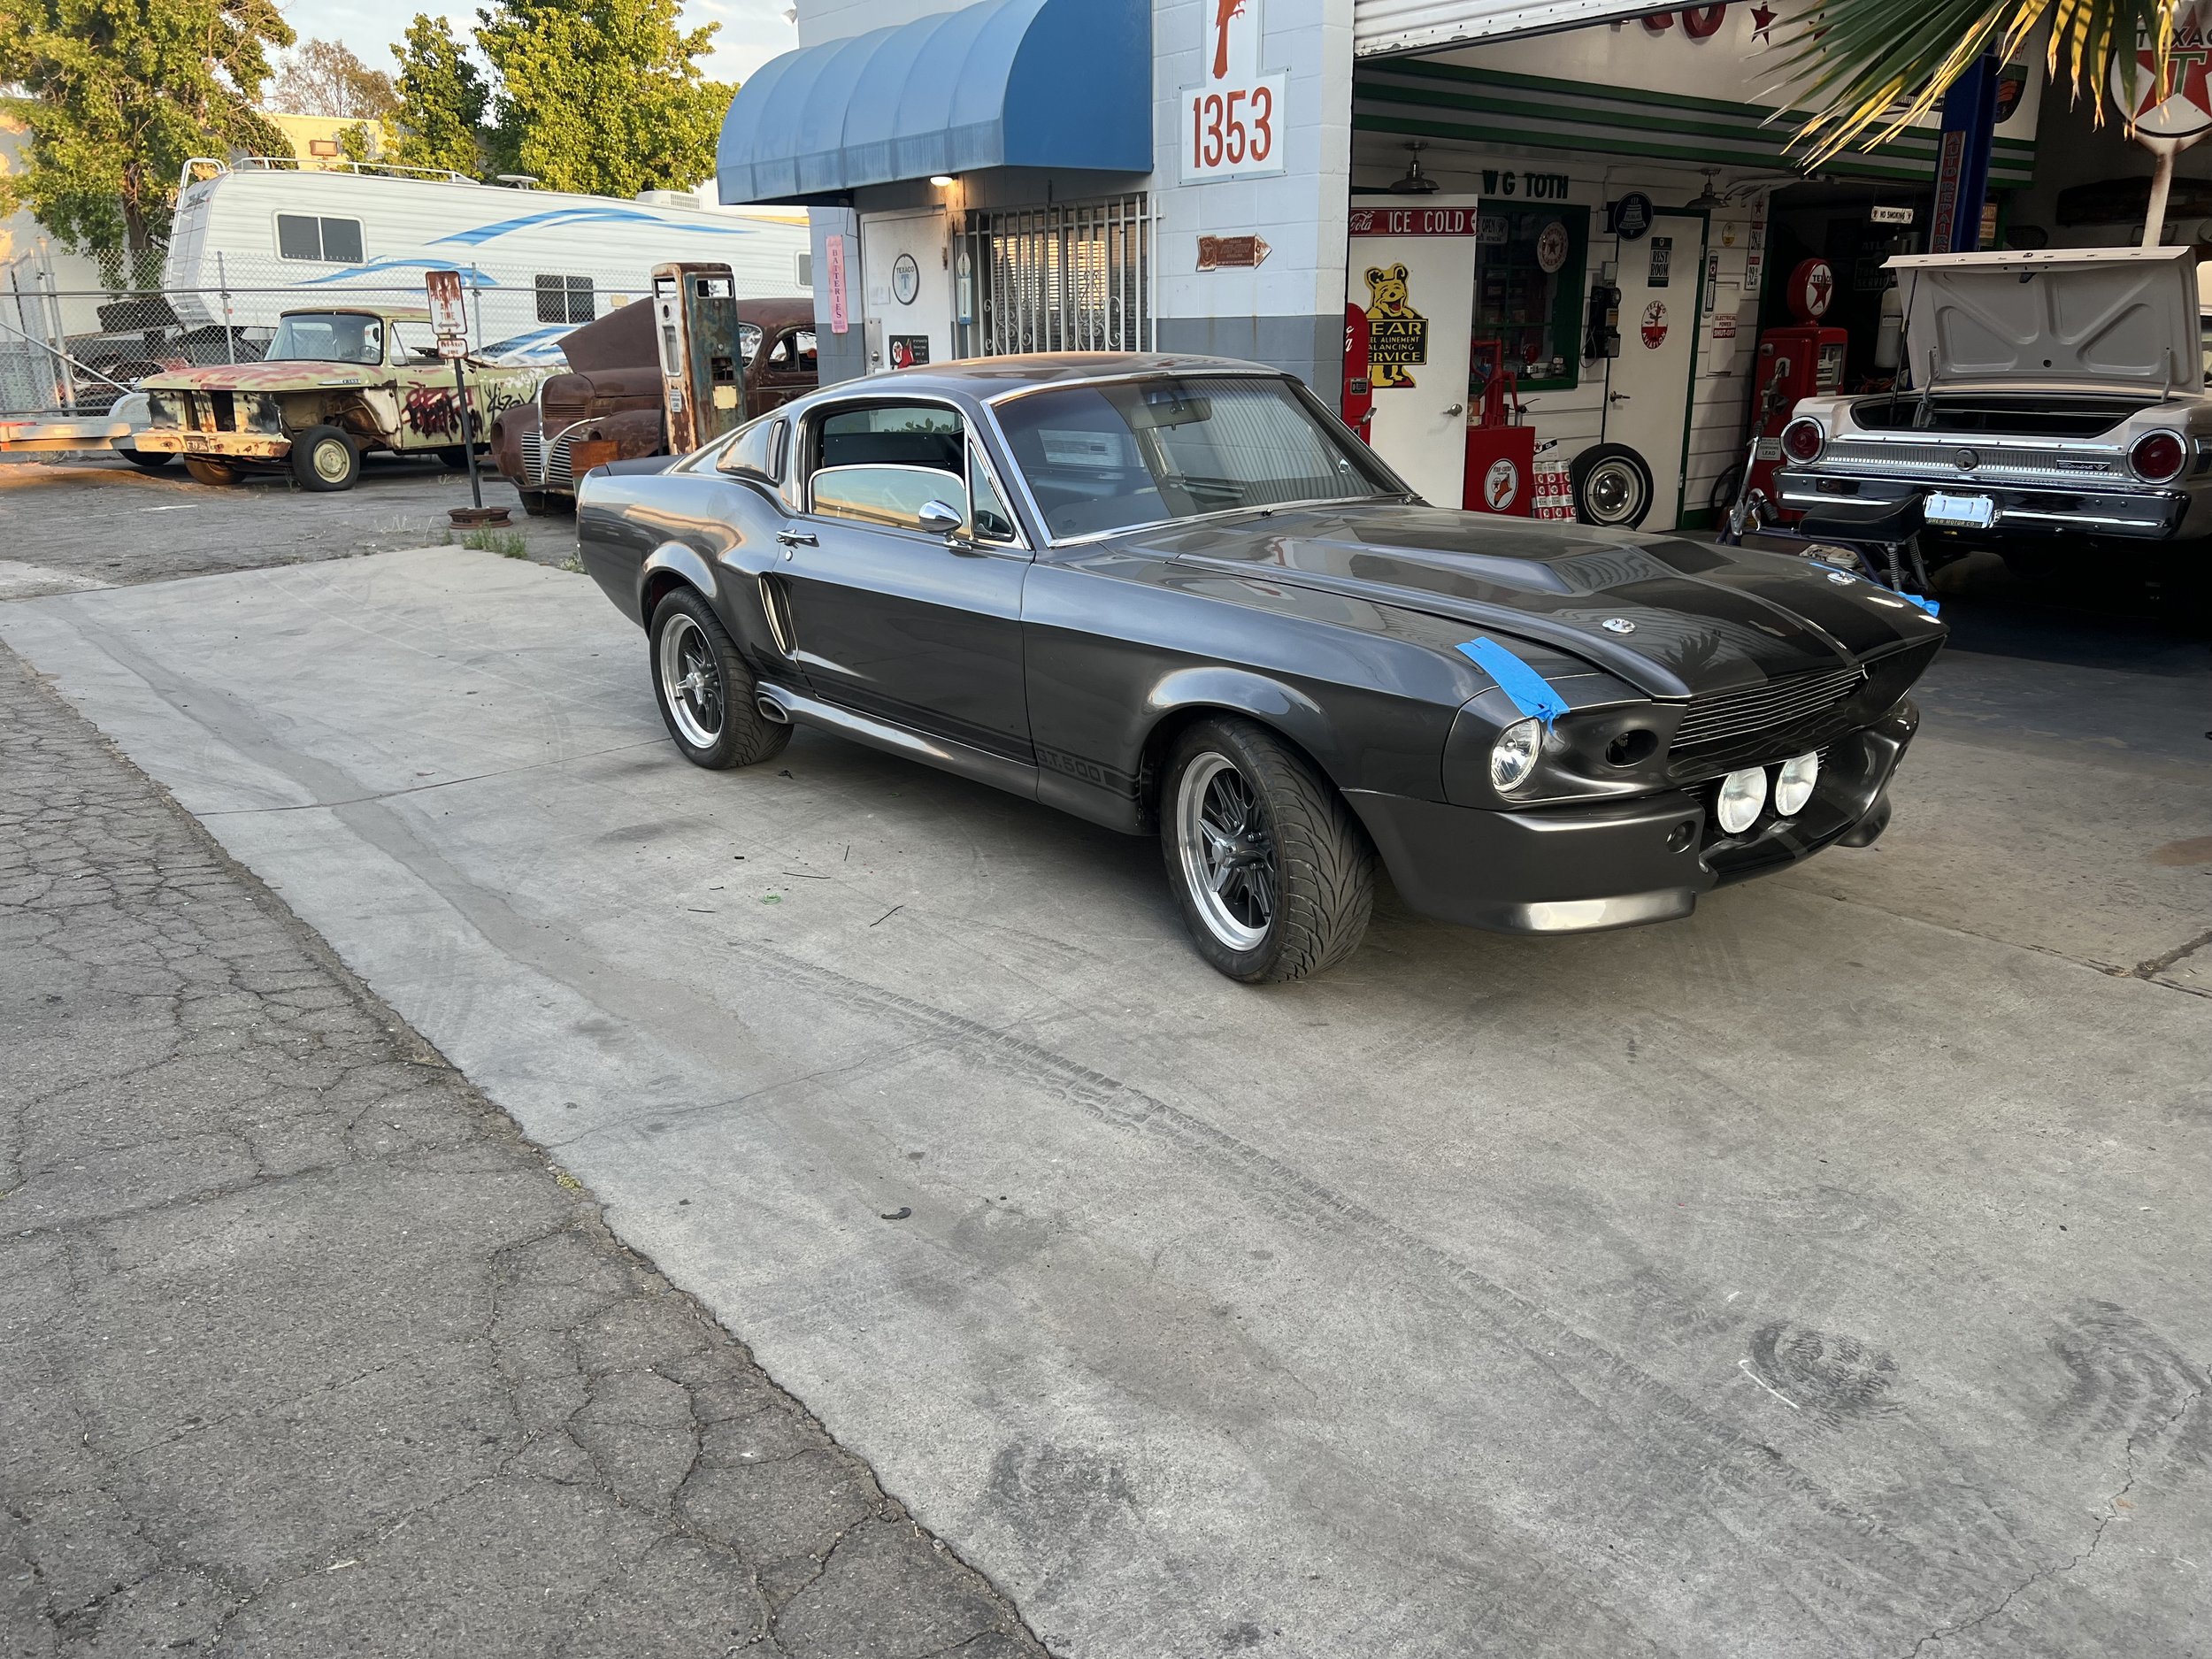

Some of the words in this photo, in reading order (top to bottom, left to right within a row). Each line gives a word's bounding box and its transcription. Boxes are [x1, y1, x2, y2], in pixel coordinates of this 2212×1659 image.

[1193, 87, 1272, 169] 1353
[1943, 134, 1961, 178] AUTO
[1524, 173, 1570, 199] TOTH
[1388, 211, 1412, 233] ICE
[1424, 211, 1464, 233] COLD
[1934, 181, 1955, 253] REPAIRS
[1652, 251, 1670, 263] REST
[896, 265, 915, 274] TEXACO
[1650, 264, 1669, 276] ROOM
[832, 249, 842, 319] BATTERIES
[1371, 322, 1422, 335] EAR
[1642, 331, 1666, 349] AVIATION
[1368, 352, 1421, 362] ERVICE
